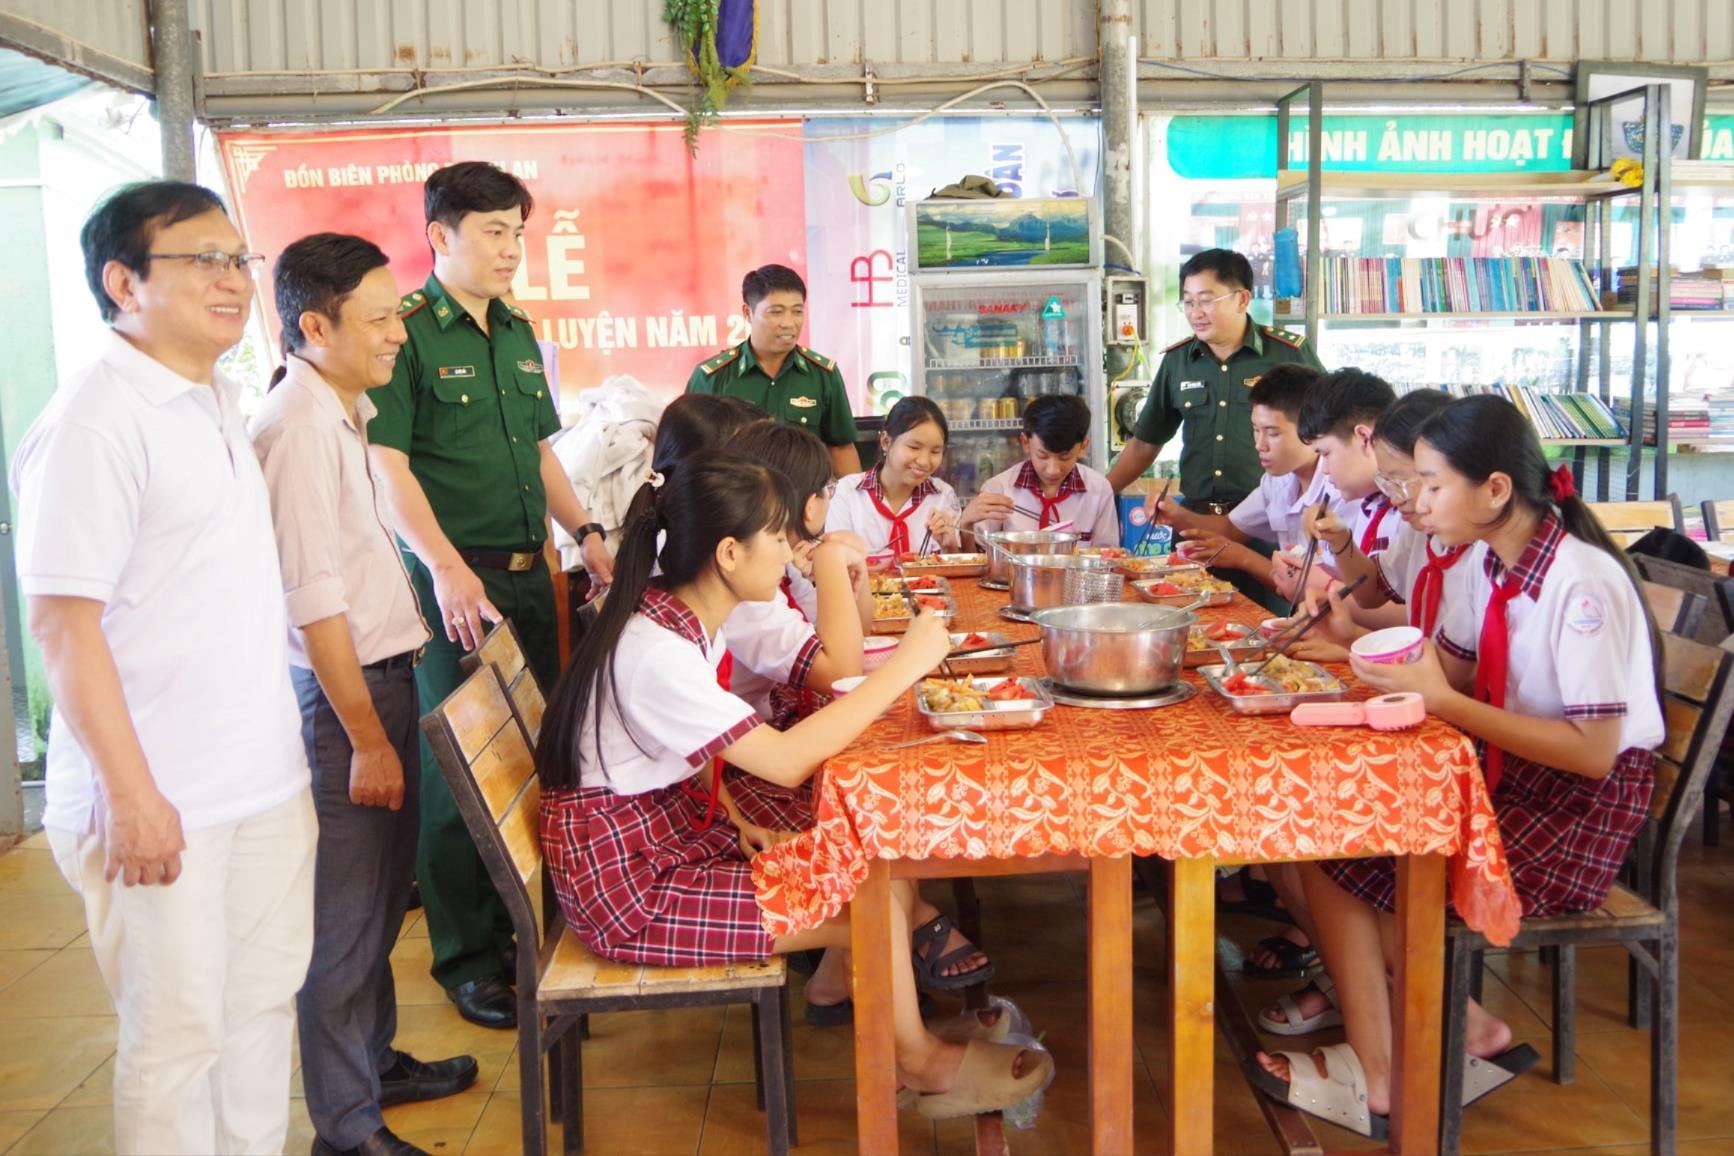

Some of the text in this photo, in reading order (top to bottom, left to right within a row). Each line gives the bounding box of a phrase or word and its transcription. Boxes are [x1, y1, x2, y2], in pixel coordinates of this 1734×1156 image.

[1377, 120, 1452, 161] ẢNH
[1463, 131, 1554, 167] HOẠT
[328, 163, 373, 187] BIÊN
[511, 209, 591, 301] LỄ
[896, 249, 908, 307] MEDICAL
[541, 311, 638, 356] LUYỆN
[646, 309, 718, 348] NĂM
